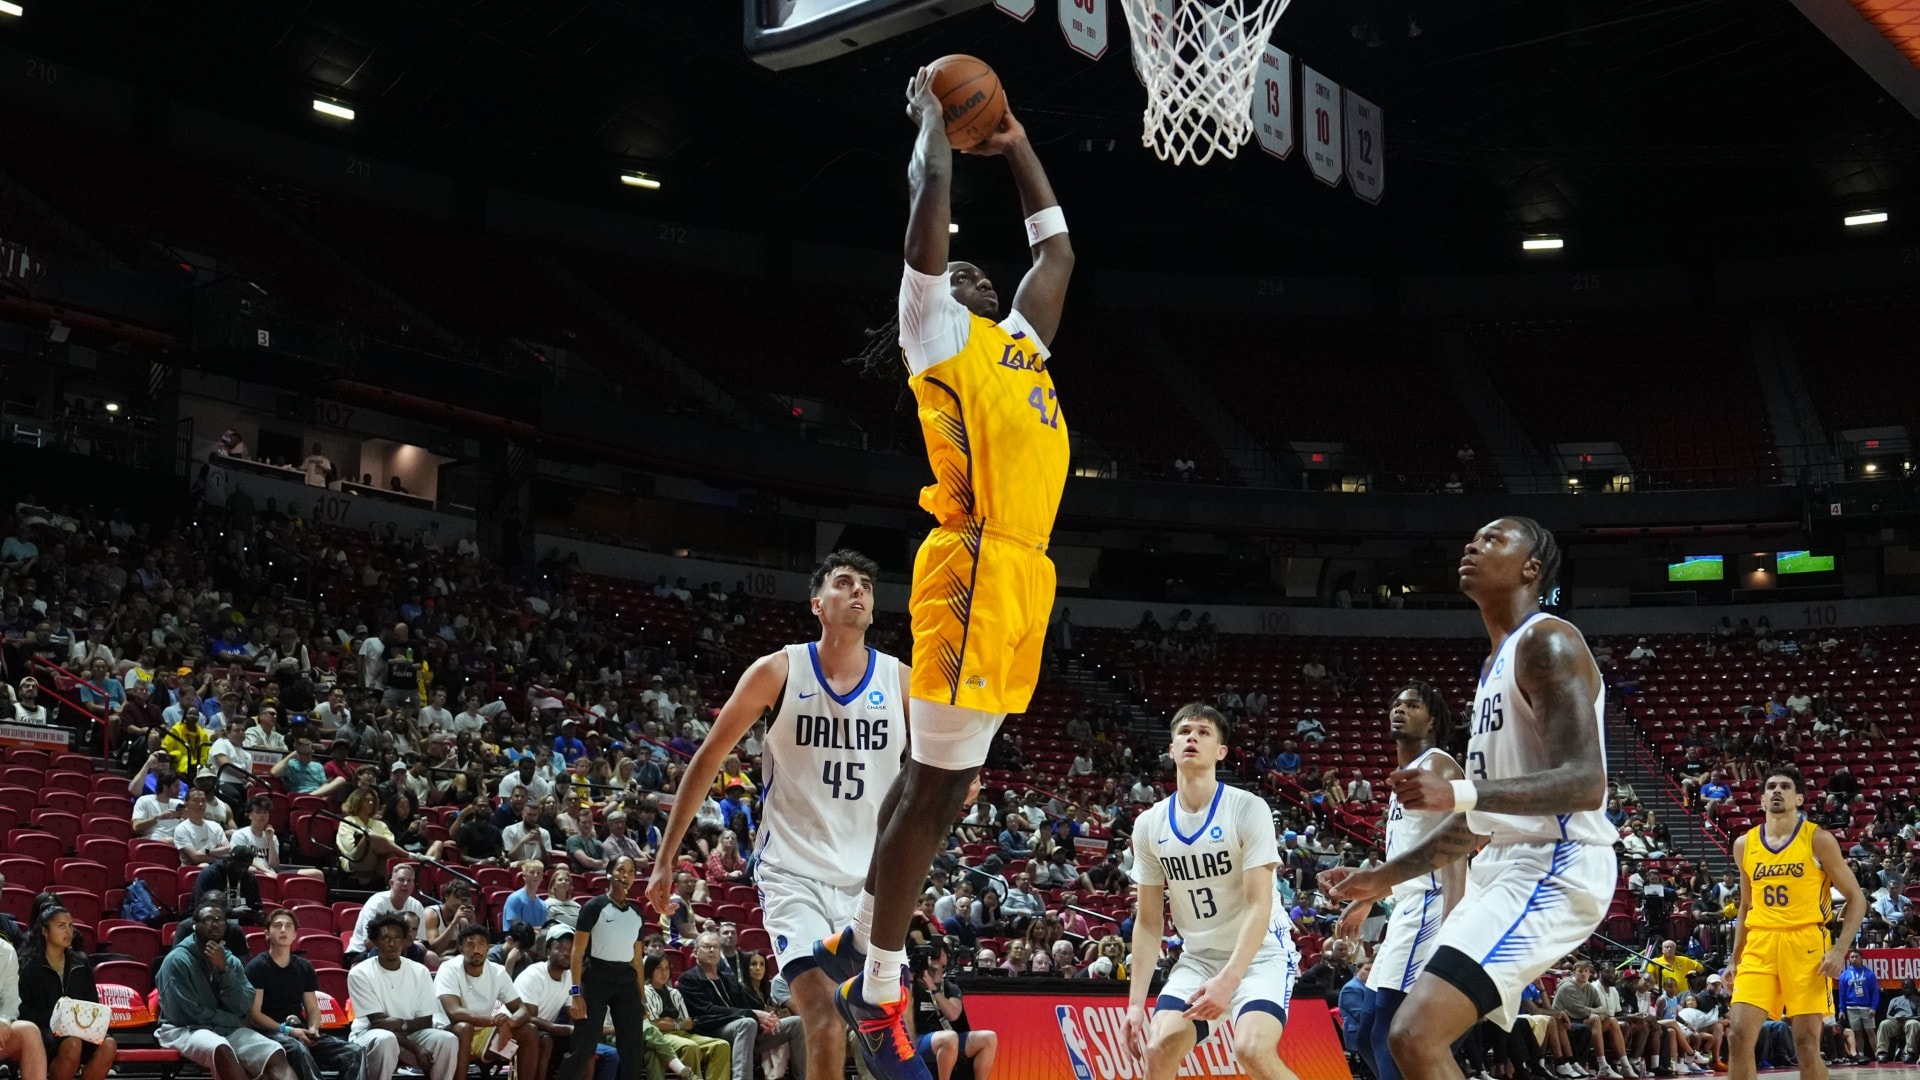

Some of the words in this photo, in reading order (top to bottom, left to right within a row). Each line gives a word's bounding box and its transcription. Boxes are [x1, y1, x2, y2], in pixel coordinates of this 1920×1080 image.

[26, 59, 57, 84] 210
[1265, 78, 1280, 117] 13
[1315, 107, 1330, 146] 10
[1358, 128, 1373, 166] 12
[345, 156, 371, 178] 211
[660, 224, 686, 244] 212
[259, 332, 267, 345] 3
[317, 403, 354, 428] 107
[1028, 386, 1059, 429] 47
[317, 495, 351, 522] 107
[1831, 504, 1840, 514] 4
[745, 572, 776, 595] 108
[1260, 611, 1290, 632] 109
[1802, 605, 1837, 625] 110
[796, 714, 888, 750] DALLAS
[822, 760, 865, 801] 45
[1160, 850, 1233, 881] DALLAS
[1753, 862, 1804, 881] LAKERS
[1187, 887, 1218, 920] 13
[1764, 884, 1788, 907] 66
